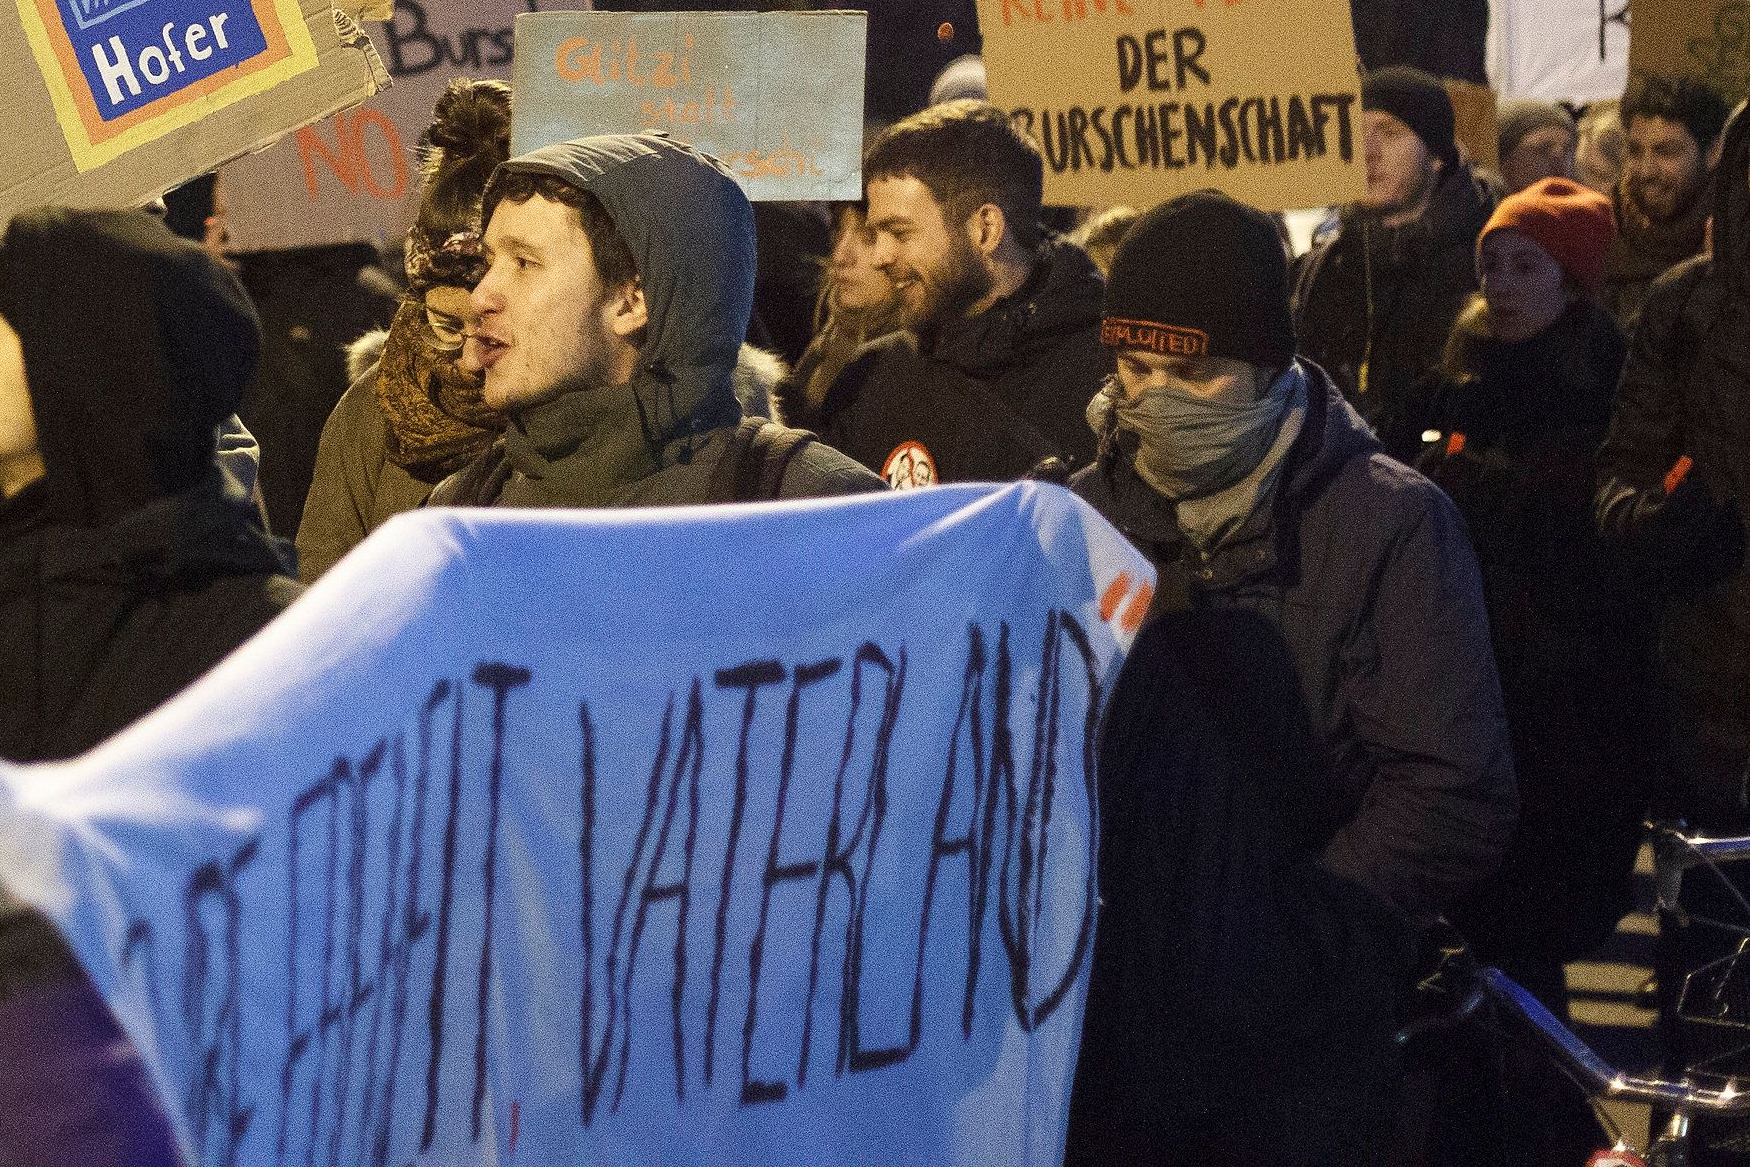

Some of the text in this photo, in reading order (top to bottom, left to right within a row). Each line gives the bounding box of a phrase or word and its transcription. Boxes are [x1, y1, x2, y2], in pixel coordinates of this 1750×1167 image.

[90, 11, 230, 107] Hofer
[1115, 27, 1213, 95] DER
[295, 104, 409, 203] NO
[578, 607, 1103, 1132] VATERLAND
